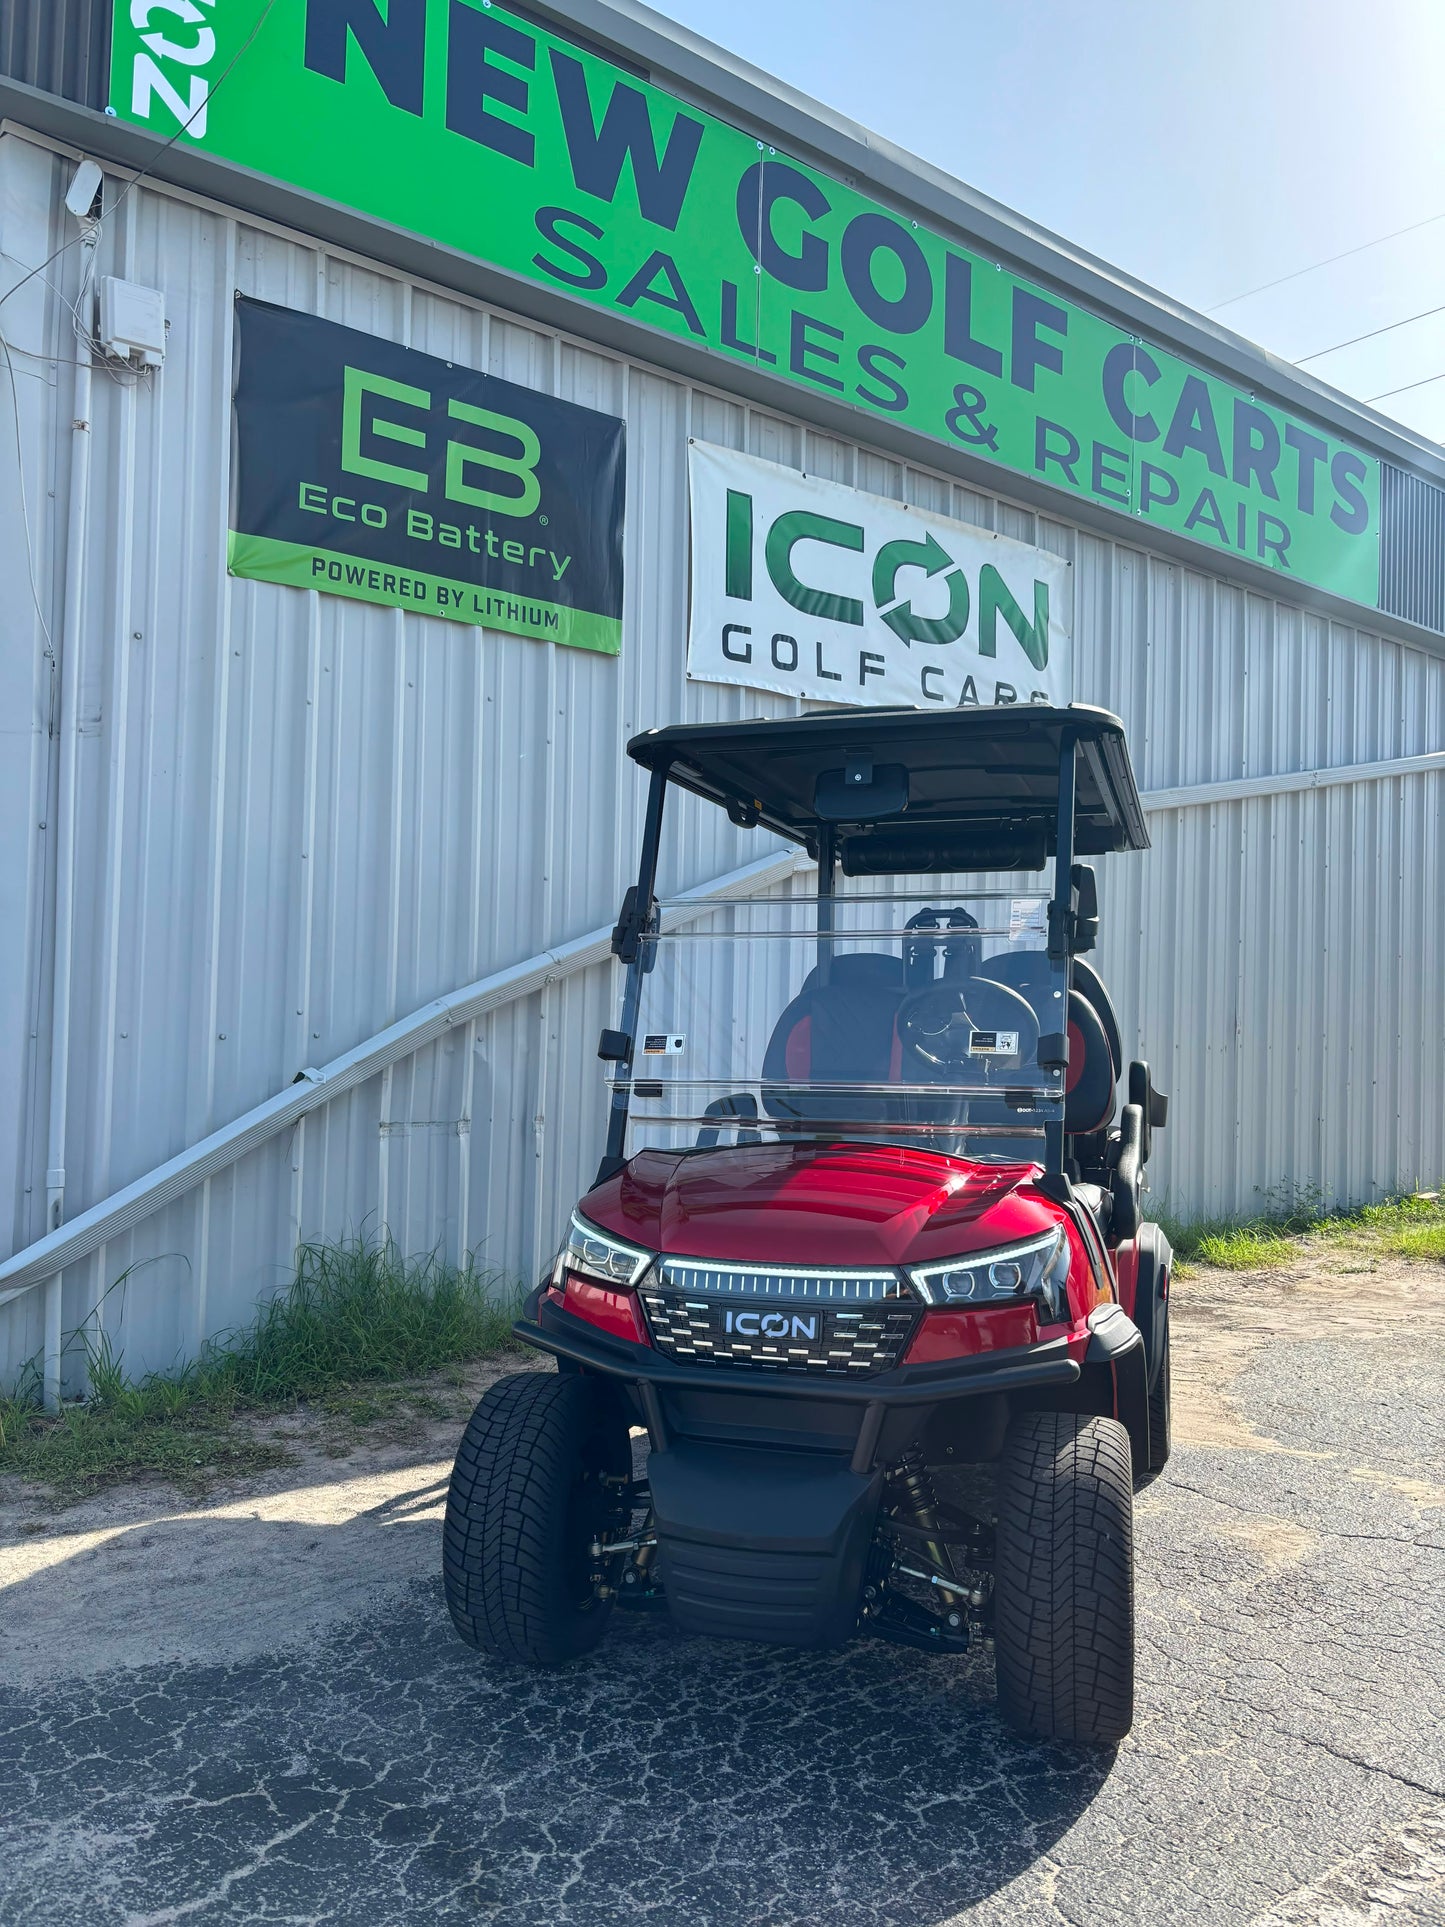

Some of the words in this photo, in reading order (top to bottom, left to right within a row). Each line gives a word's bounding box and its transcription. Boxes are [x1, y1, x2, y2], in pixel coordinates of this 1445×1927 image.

[303, 0, 706, 233] NEW
[735, 160, 1068, 394] GOLF
[1102, 342, 1370, 537] CARTS
[531, 206, 909, 413] SALES
[945, 383, 1001, 452] &
[1034, 416, 1292, 568] REPAIR
[299, 481, 388, 529] Eco
[407, 509, 572, 581] Battery
[725, 488, 1050, 672] ICON
[312, 556, 427, 600] POWERED
[436, 585, 464, 609] BY
[473, 594, 559, 631] LITHIUM
[722, 624, 886, 686] GOLF
[725, 1311, 816, 1339] ICON
